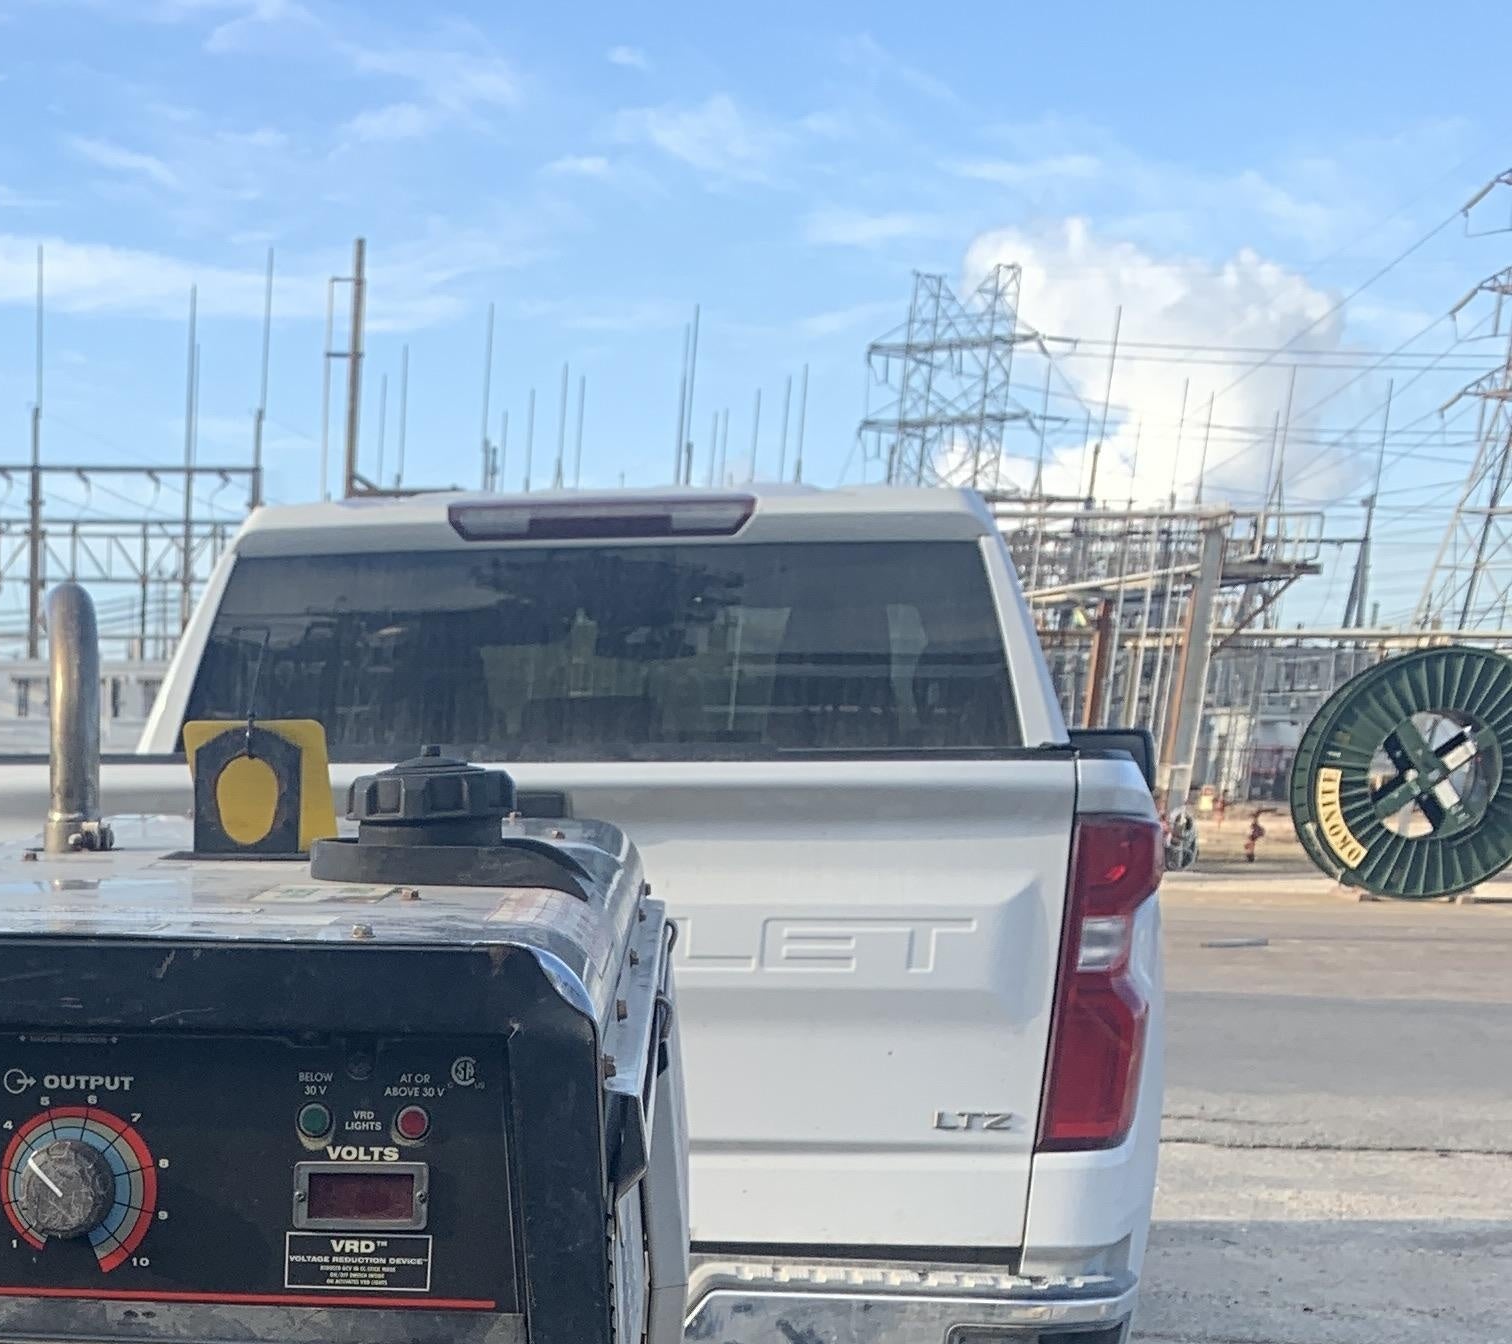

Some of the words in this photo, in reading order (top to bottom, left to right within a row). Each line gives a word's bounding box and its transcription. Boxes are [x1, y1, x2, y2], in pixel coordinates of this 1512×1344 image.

[43, 1074, 135, 1091] OUTPUT
[299, 1071, 333, 1083] BELOW
[399, 1073, 413, 1084] AT
[414, 1073, 431, 1084] OR
[304, 1085, 316, 1096] 30
[317, 1085, 328, 1096] V
[384, 1085, 421, 1097] ABOVE
[422, 1086, 435, 1097] 30
[436, 1086, 445, 1098] V
[40, 1096, 50, 1106] 5
[87, 1095, 98, 1104] 6
[131, 1112, 142, 1122] 7
[353, 1110, 374, 1121] VRD
[933, 1110, 1014, 1131] LTZ
[3, 1120, 13, 1130] 4
[344, 1120, 382, 1132] LIGHTS
[326, 1146, 400, 1162] VOLTS
[158, 1158, 169, 1169] 8
[158, 1210, 168, 1221] 9
[11, 1239, 17, 1249] 1
[131, 1256, 150, 1267] 10
[289, 1255, 330, 1263] VOLTAGE
[332, 1256, 387, 1264] REDUCTION
